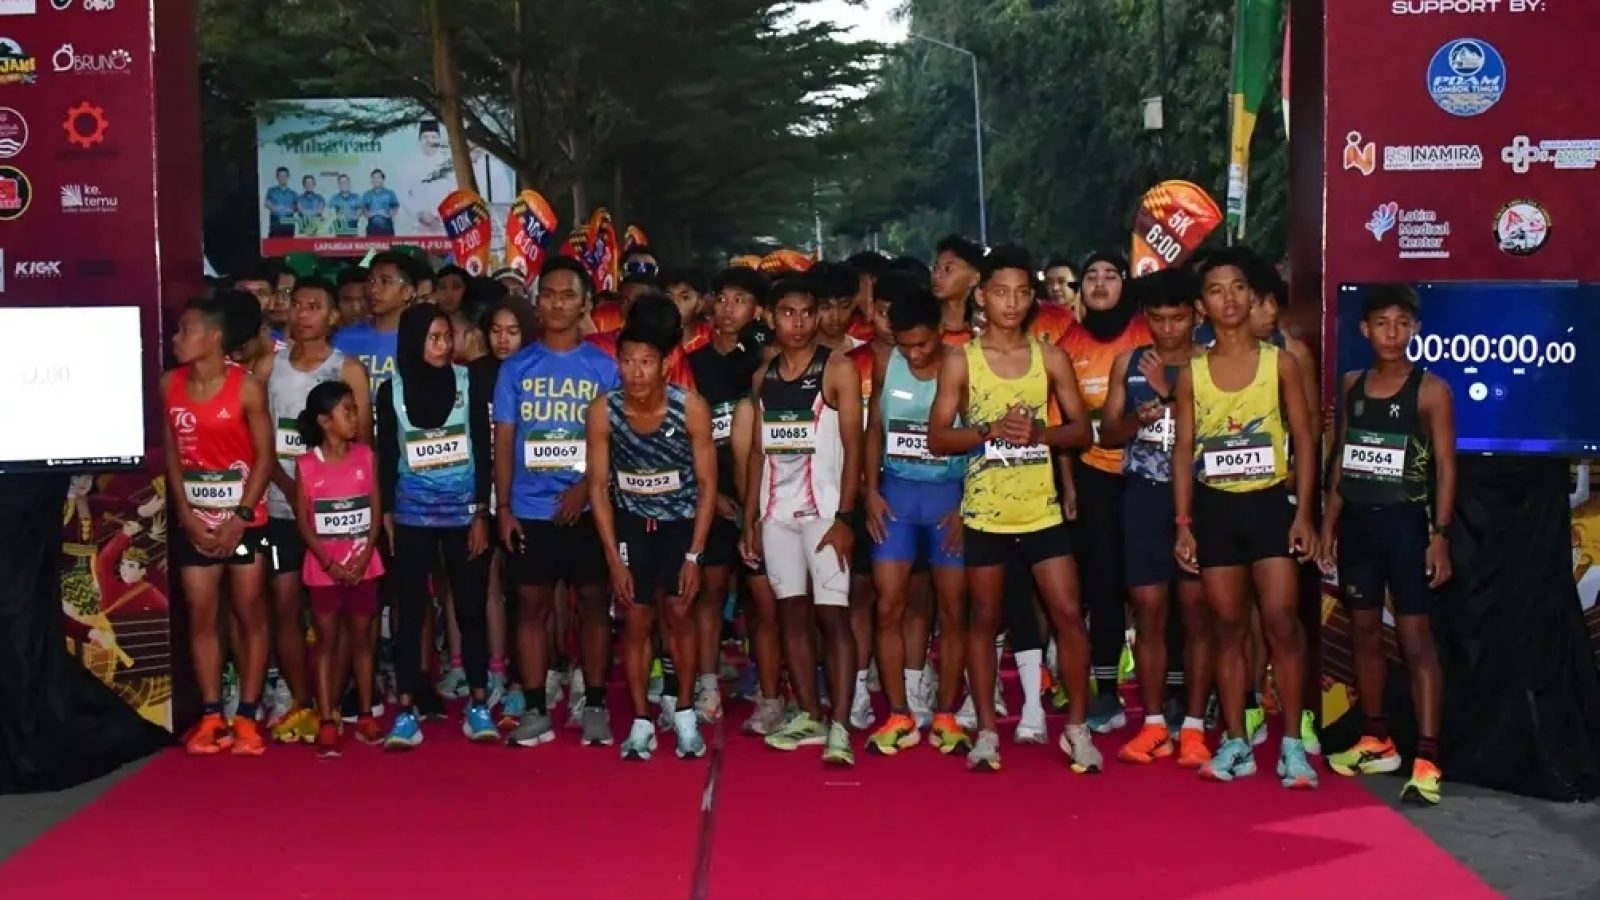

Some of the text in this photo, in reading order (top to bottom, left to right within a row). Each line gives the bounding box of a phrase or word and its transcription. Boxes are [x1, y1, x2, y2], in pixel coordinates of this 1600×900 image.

[1392, 0, 1547, 14] SUPPORT BY:
[1433, 75, 1500, 86] PDAM
[1415, 147, 1480, 160] NAMIRA
[84, 196, 118, 207] temu
[1167, 208, 1195, 238] 5K
[1145, 224, 1182, 263] 6:00
[770, 426, 808, 439] U0685
[415, 440, 459, 457] U0347
[533, 445, 578, 457] U0069
[1215, 451, 1261, 466] P0671
[1350, 448, 1393, 465] P0564
[625, 475, 671, 488] U0252
[191, 486, 233, 498] U0861
[323, 512, 364, 527] P0237
